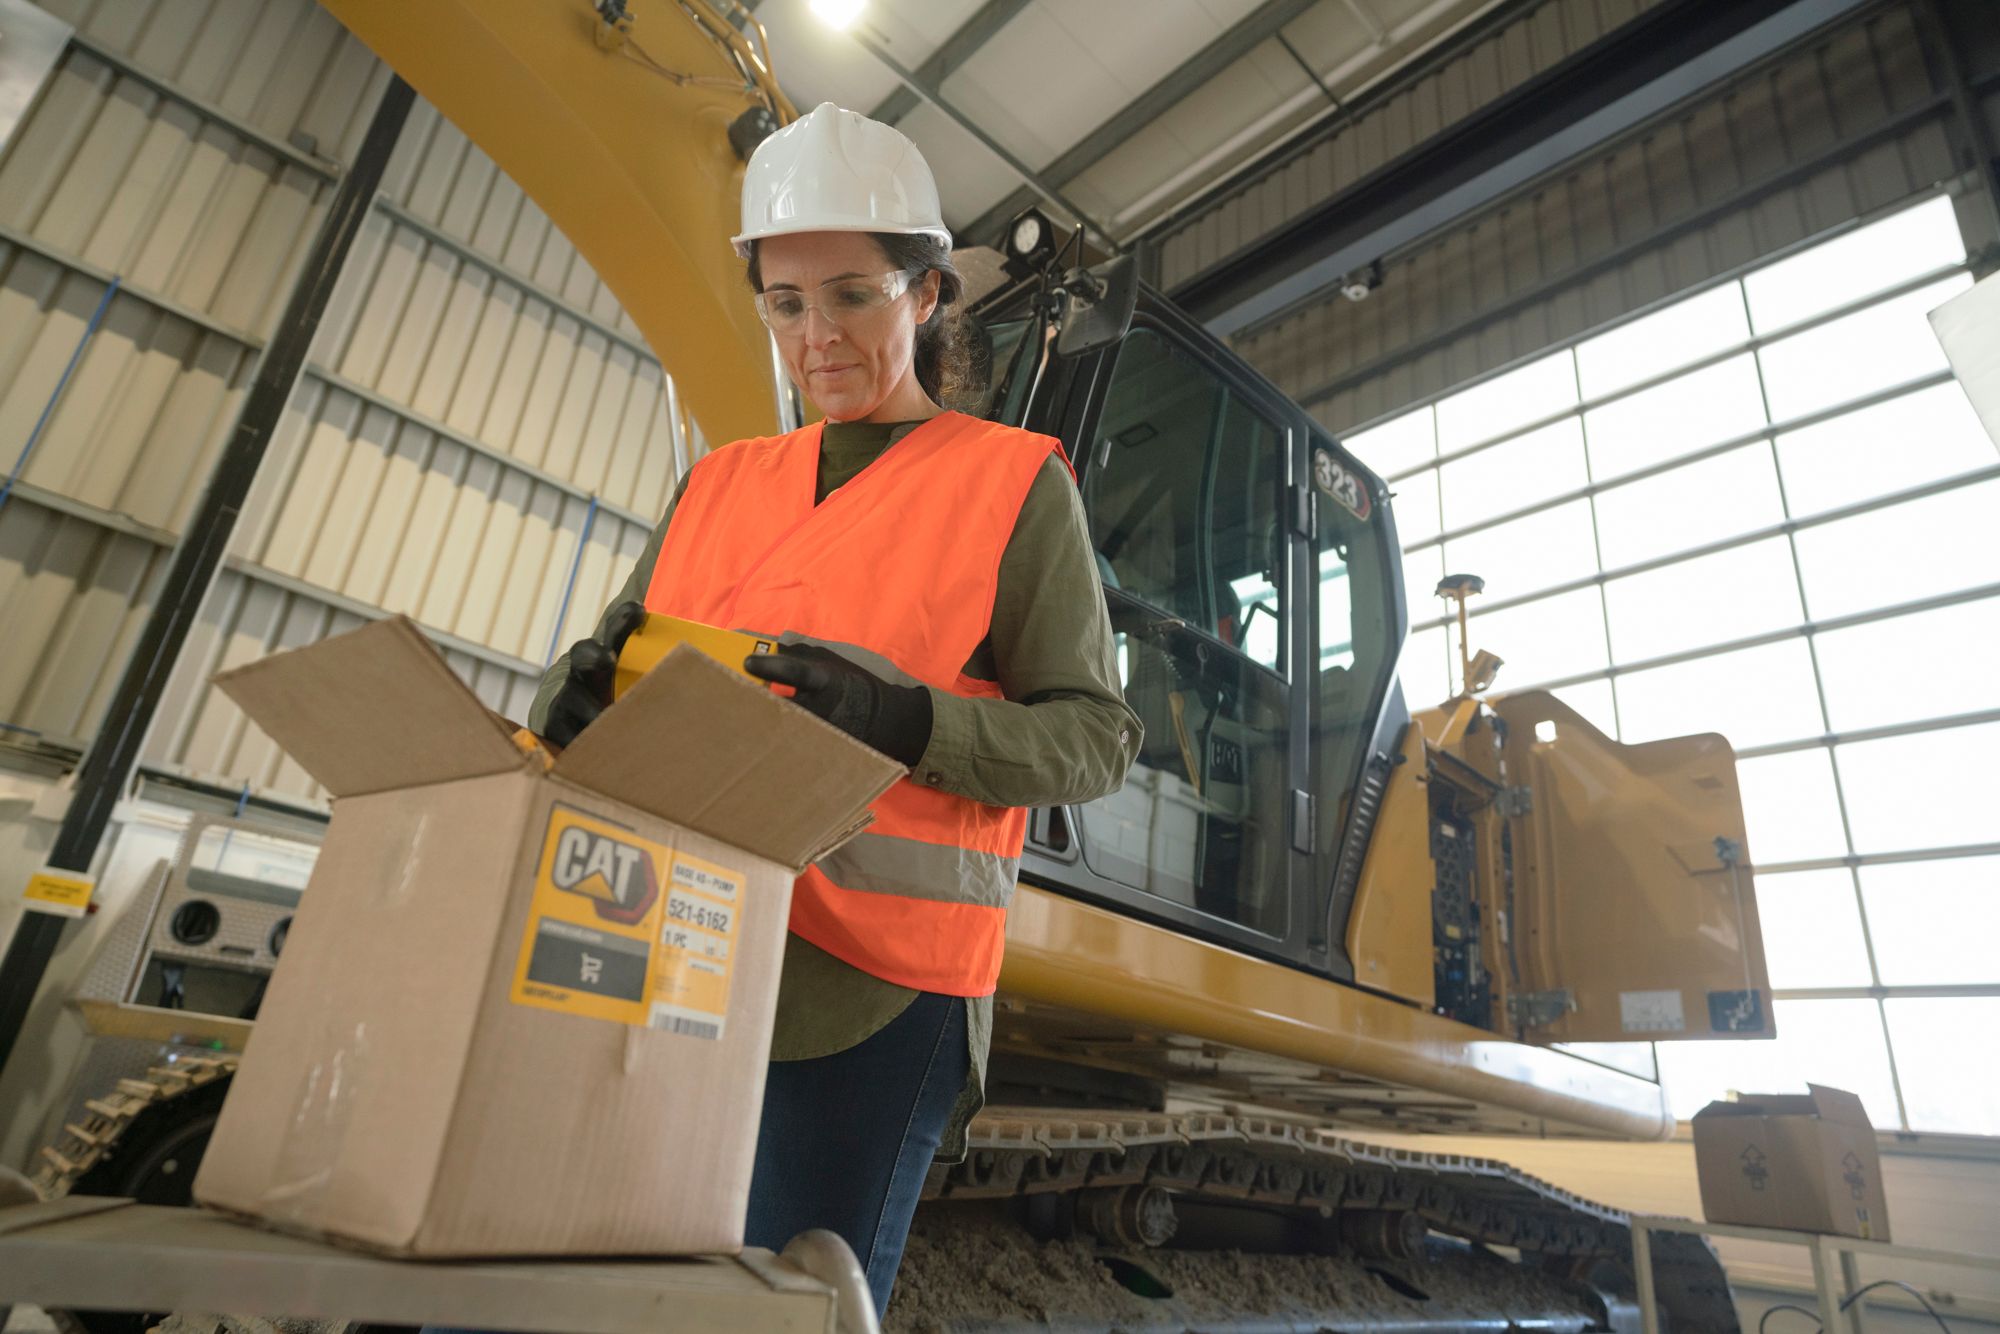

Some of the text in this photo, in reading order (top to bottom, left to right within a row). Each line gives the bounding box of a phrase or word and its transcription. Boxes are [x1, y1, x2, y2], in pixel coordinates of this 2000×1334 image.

[1315, 450, 1358, 509] 323
[553, 827, 640, 904] CAT
[713, 877, 735, 893] PUMP
[668, 898, 728, 932] 521-6162
[673, 932, 687, 949] PC
